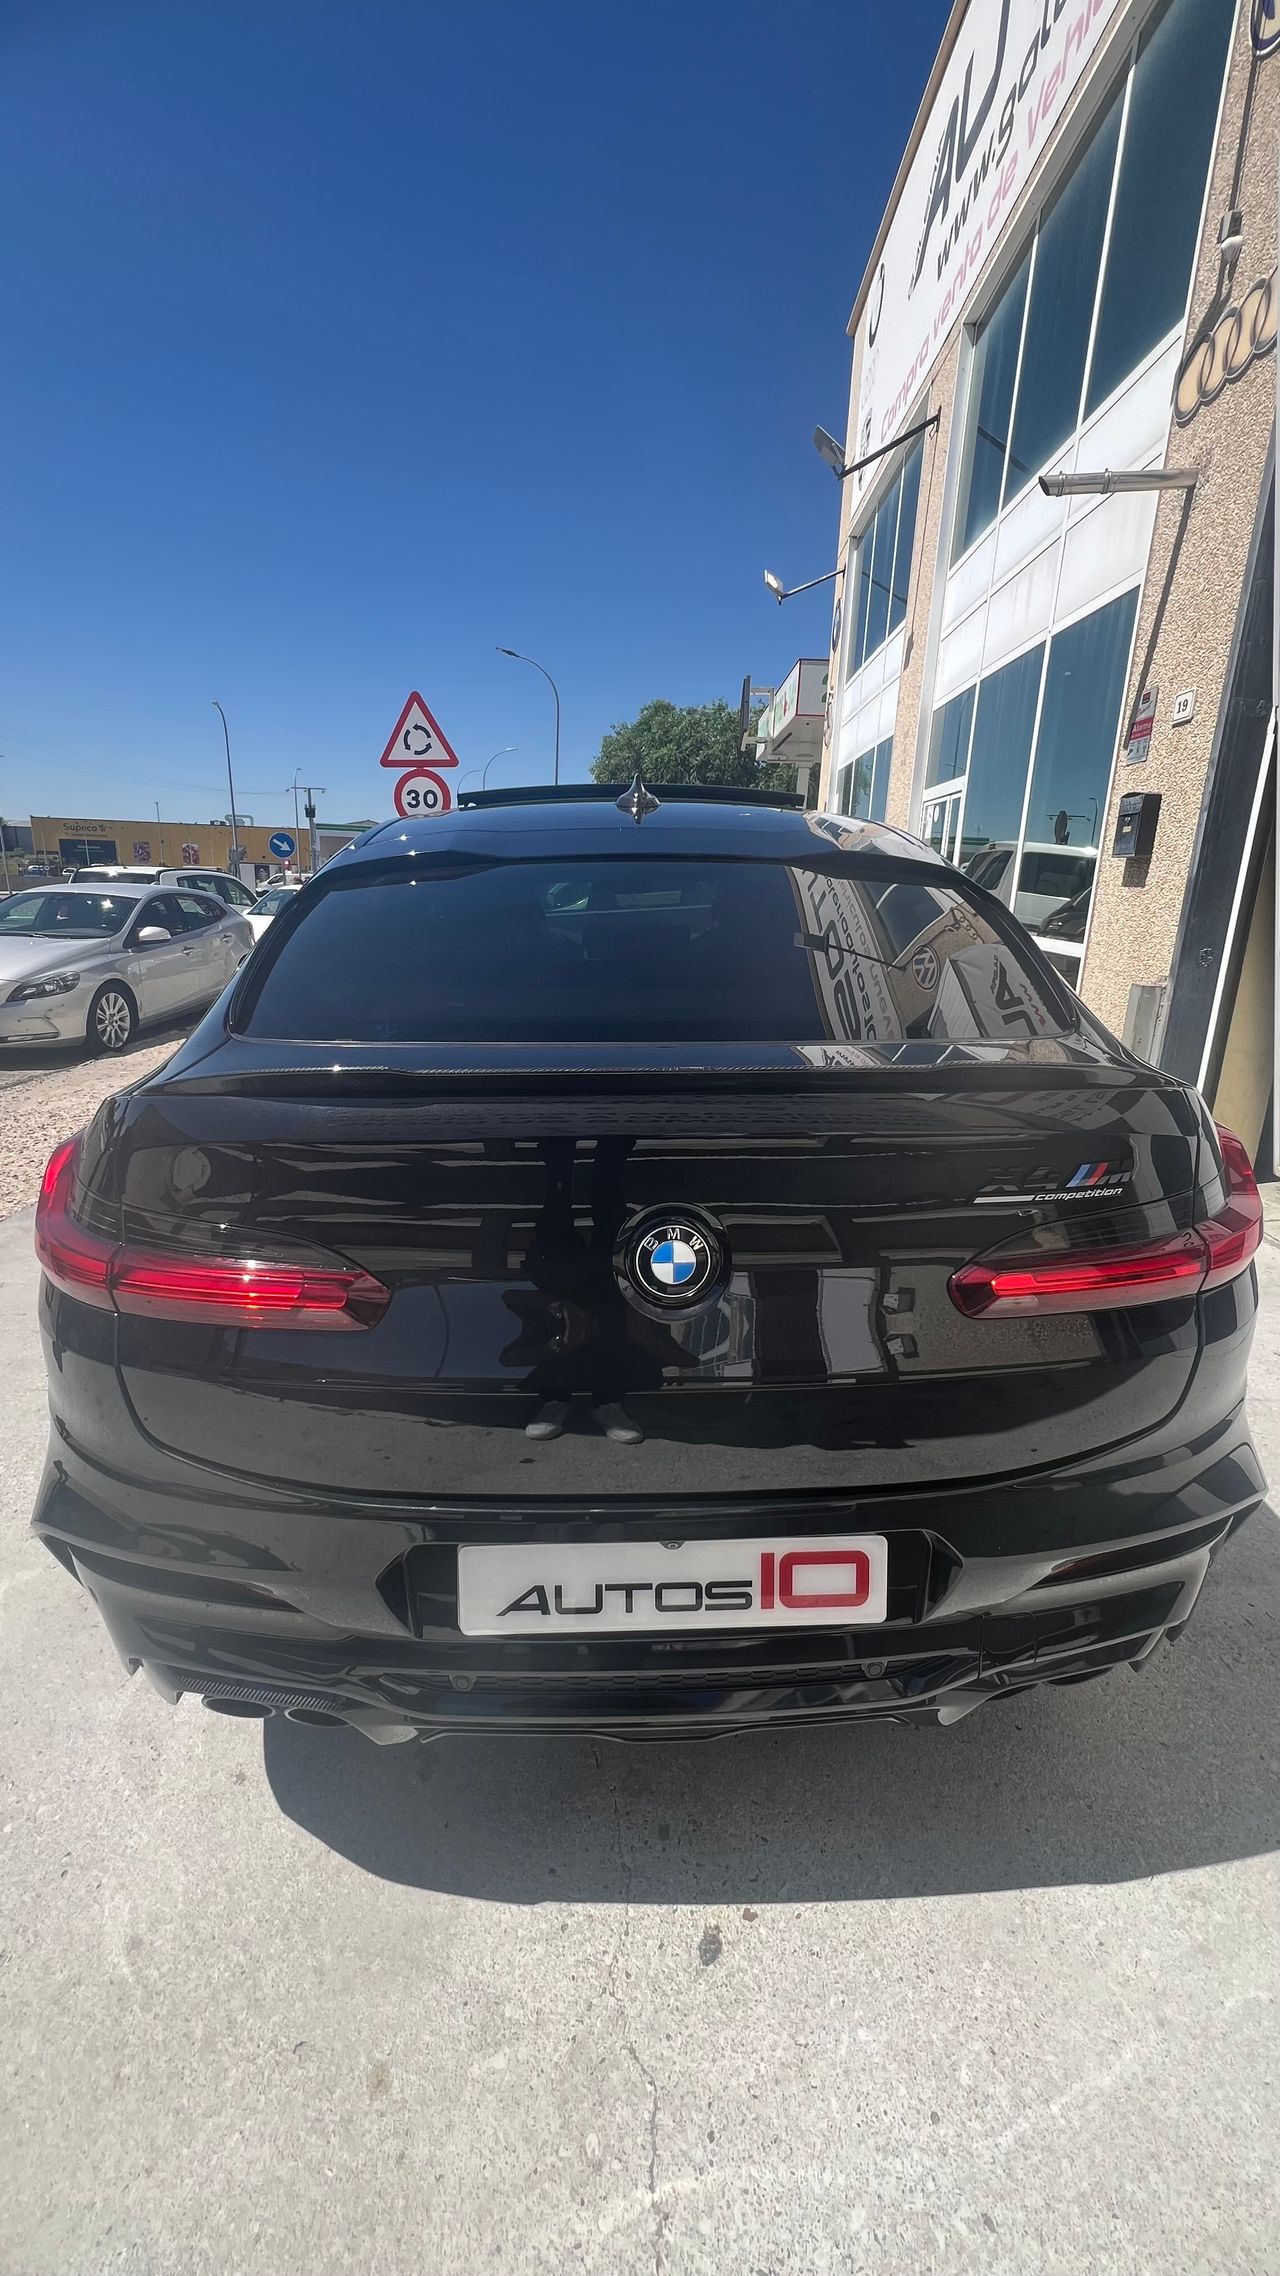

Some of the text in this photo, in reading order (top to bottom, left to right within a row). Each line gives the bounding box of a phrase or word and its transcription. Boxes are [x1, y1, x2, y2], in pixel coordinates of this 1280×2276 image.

[937, 0, 1067, 282] www.gal
[987, 150, 1019, 231] de
[1176, 698, 1189, 714] 19
[406, 789, 438, 809] 30
[63, 822, 98, 832] Supeco
[1034, 1187, 1123, 1201] competition
[643, 1228, 704, 1252] BMW
[495, 1549, 870, 1617] AUTOS10
